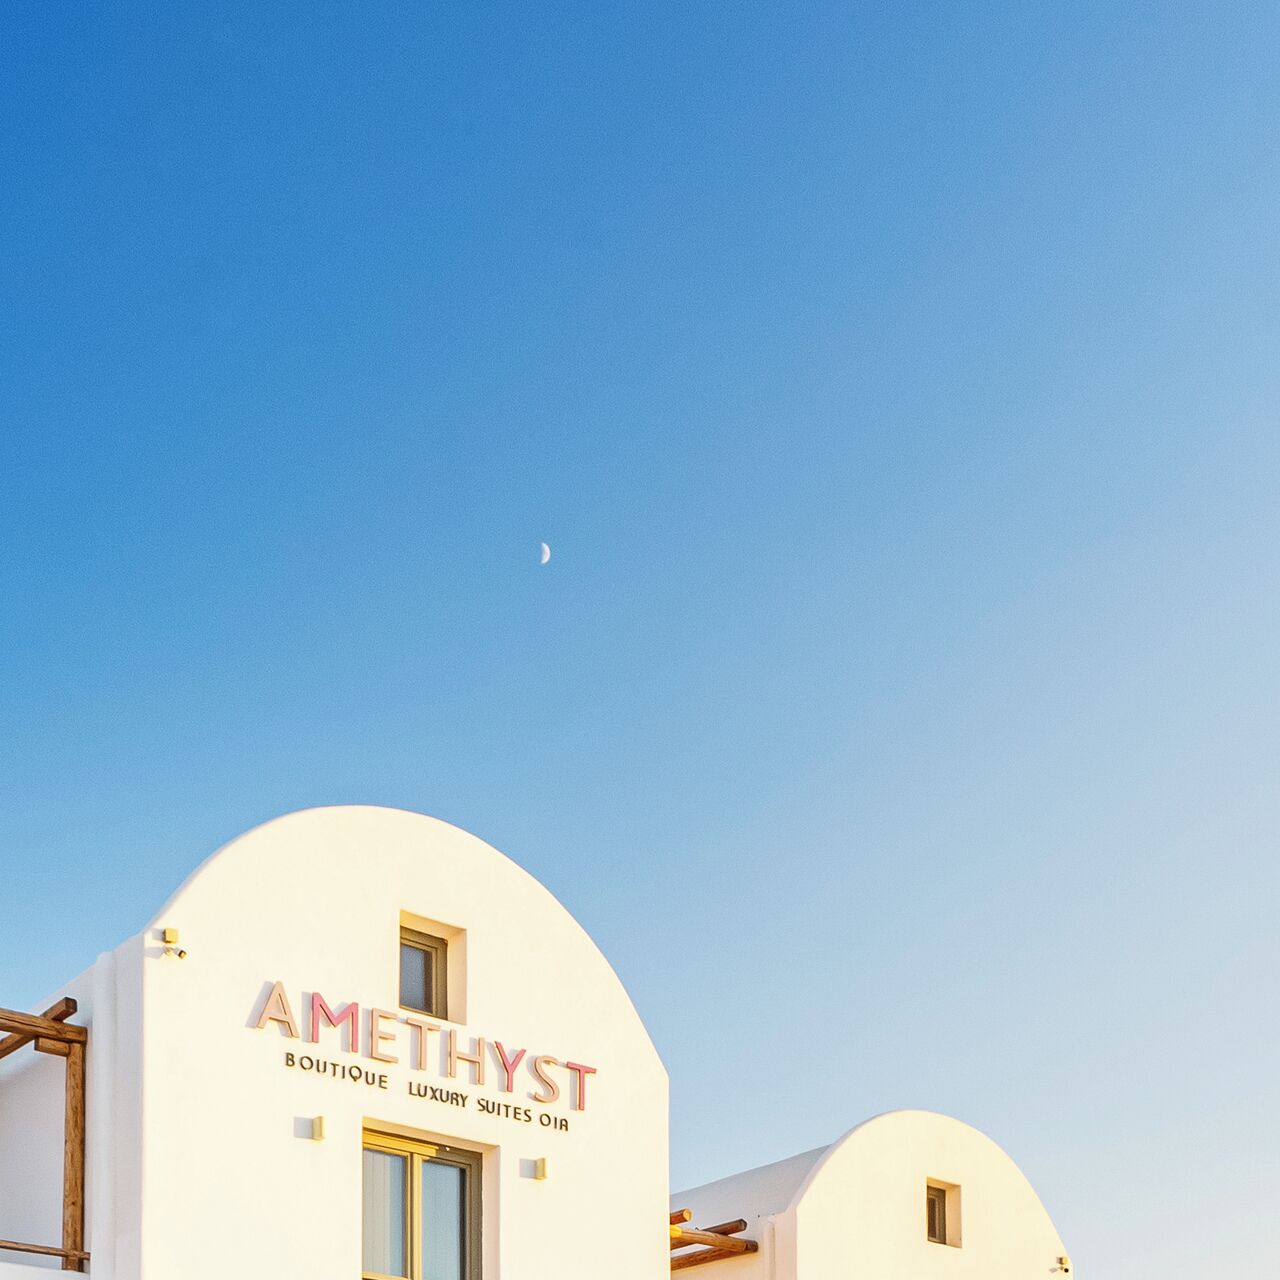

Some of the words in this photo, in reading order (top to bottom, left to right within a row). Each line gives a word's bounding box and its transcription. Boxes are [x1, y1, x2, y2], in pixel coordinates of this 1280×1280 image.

[255, 980, 598, 1112] AMETHYST
[285, 1051, 389, 1090] BOUTIQUE
[407, 1081, 469, 1109] LUXURY
[477, 1097, 532, 1123] SUITES
[539, 1112, 569, 1132] OIA
